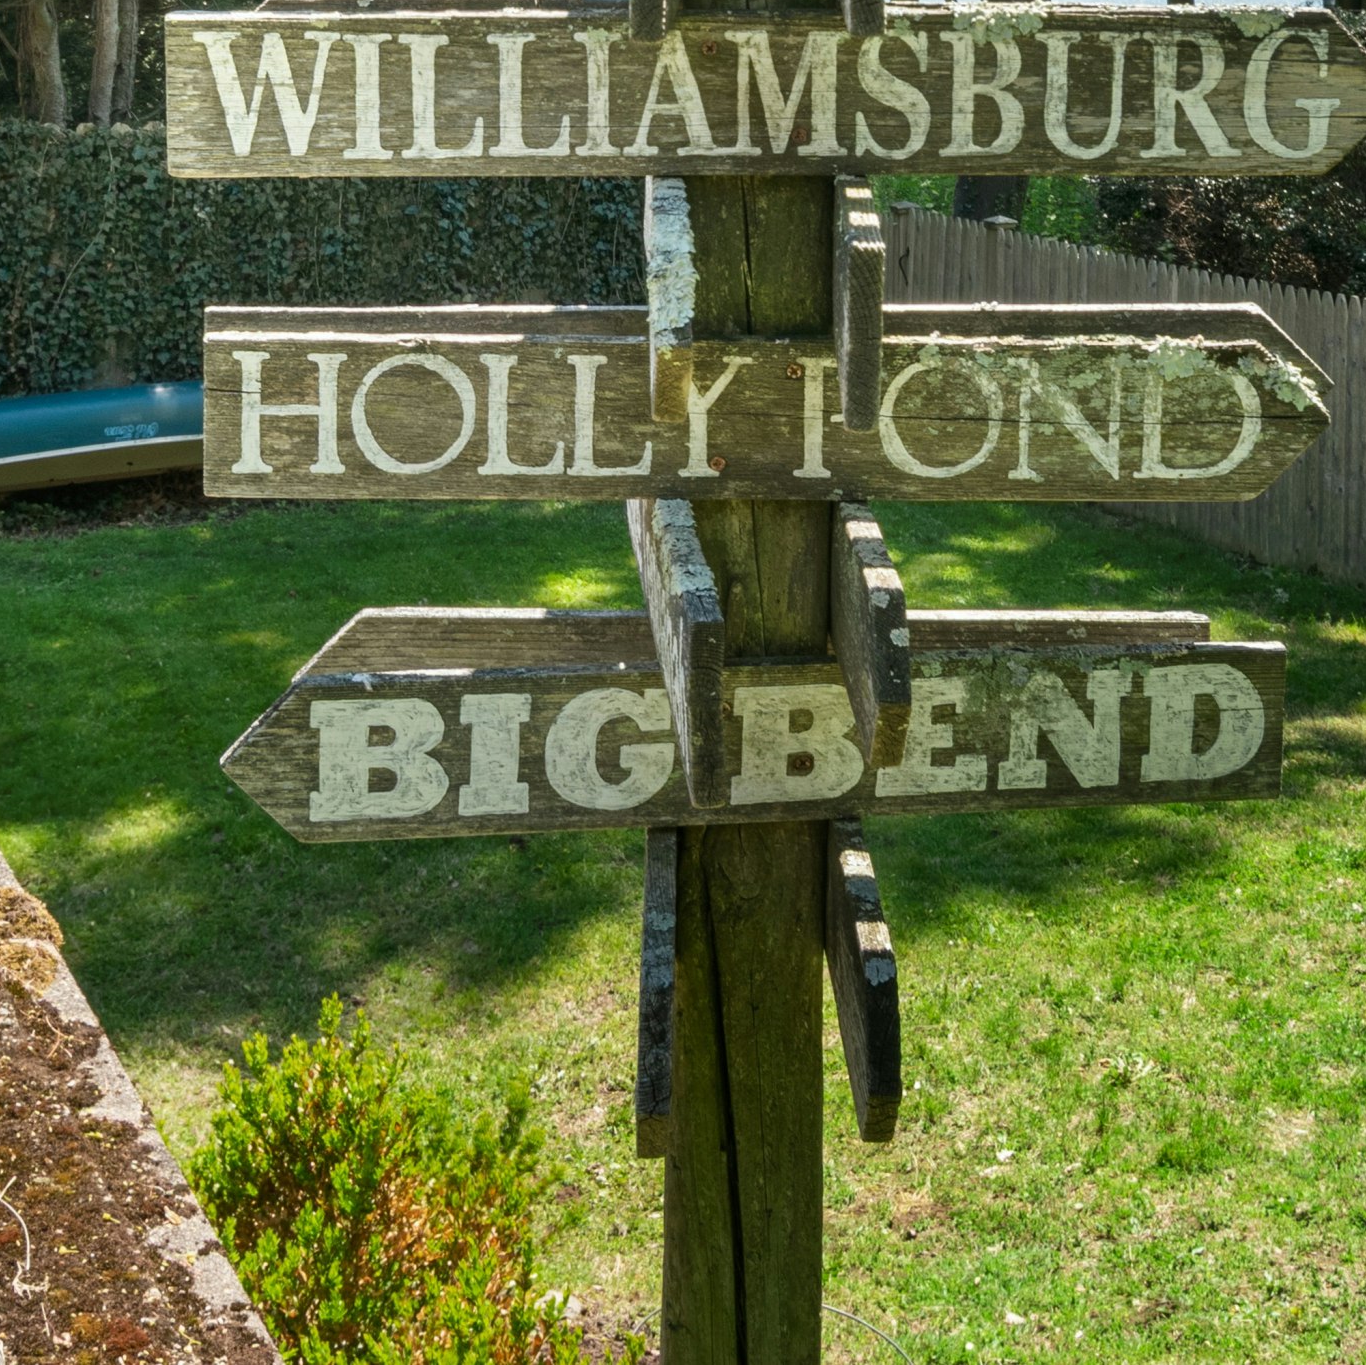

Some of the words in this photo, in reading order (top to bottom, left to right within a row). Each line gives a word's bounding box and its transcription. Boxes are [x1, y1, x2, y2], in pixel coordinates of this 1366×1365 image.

[191, 27, 1342, 162] WILLIAMSBURG
[231, 350, 753, 479] HOLLY
[309, 686, 677, 823] BIG
[730, 661, 1267, 807] BEND
